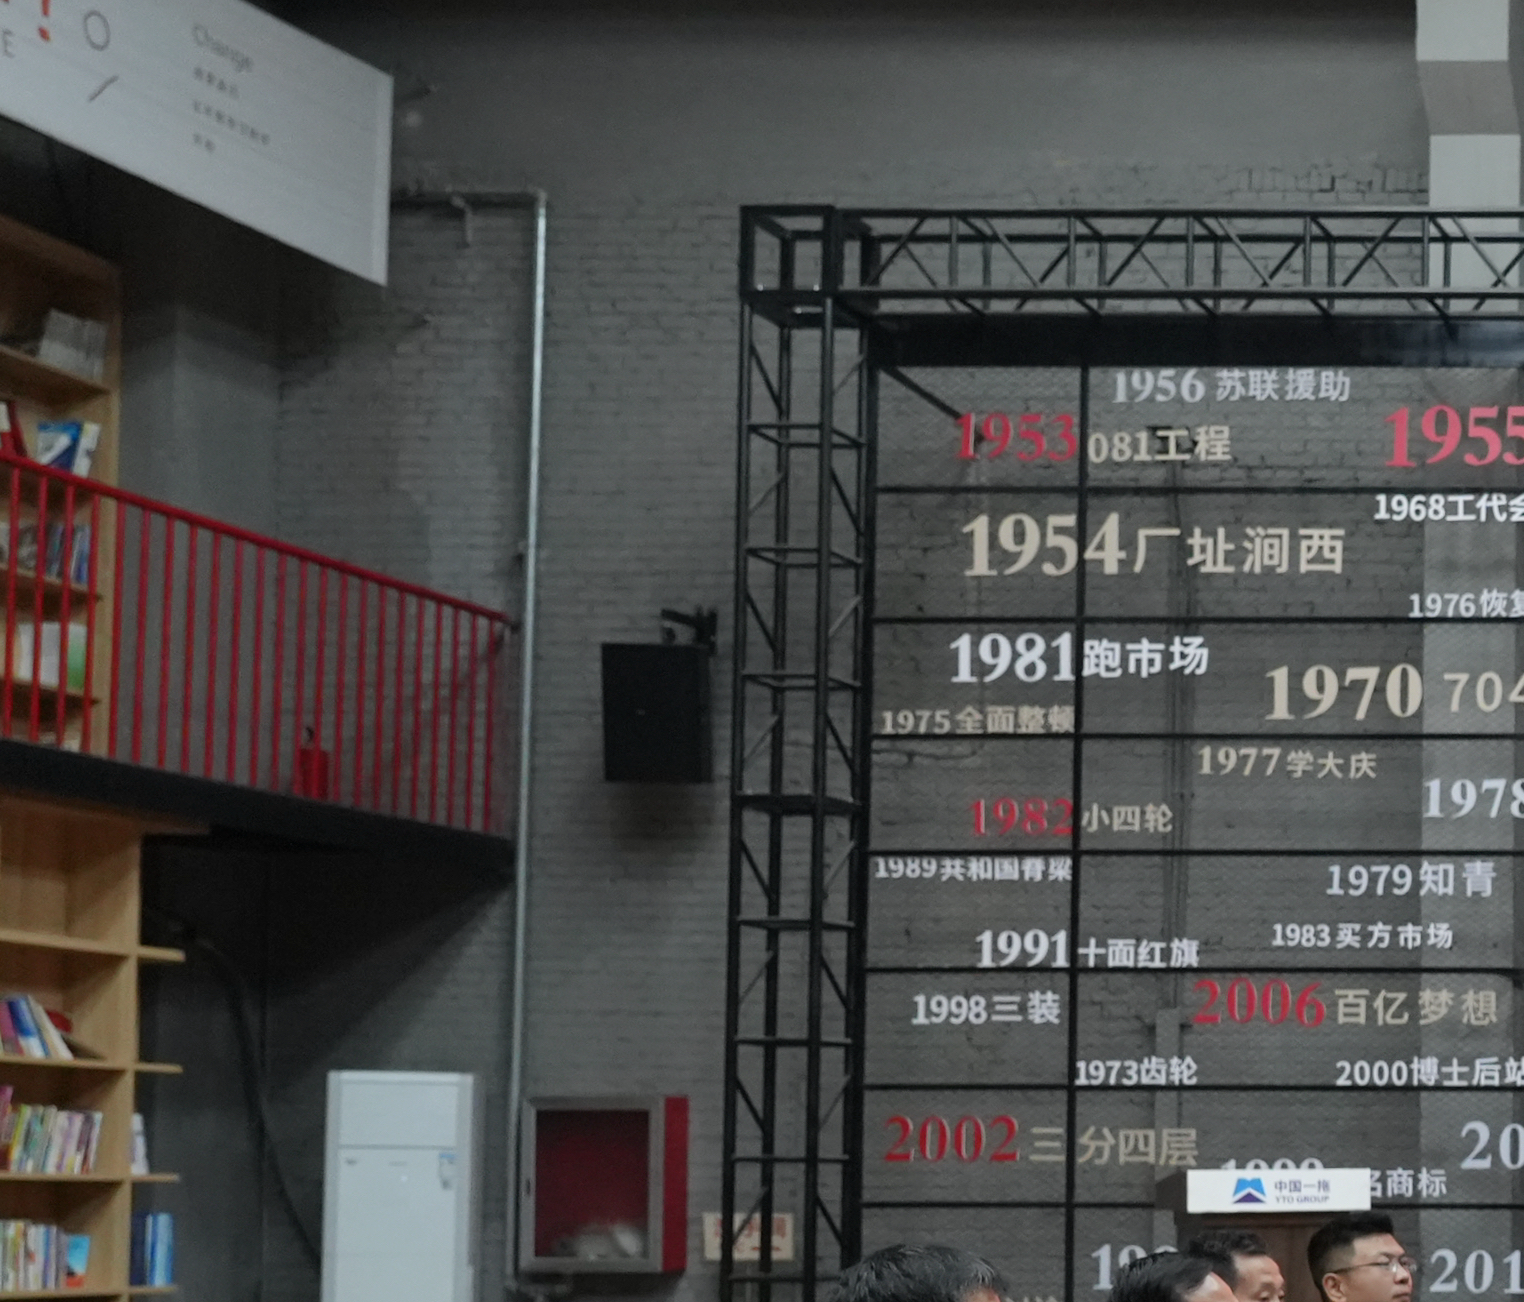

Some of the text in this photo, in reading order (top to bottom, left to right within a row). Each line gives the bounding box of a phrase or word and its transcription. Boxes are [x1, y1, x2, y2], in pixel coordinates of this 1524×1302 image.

[1112, 367, 1351, 403] 1956 苏联援助
[955, 412, 1231, 463] 1953 081工程
[962, 511, 1345, 577] 1954 厂址涧西
[949, 631, 1209, 684] 1981 跑市场
[1264, 662, 1424, 722] 1970
[969, 798, 1174, 838] 1982 小四轮
[975, 928, 1200, 969] 1991 十面红旗
[1191, 977, 1499, 1028] 2006 百亿梦想
[883, 1114, 1199, 1168] 2002 三分四层
